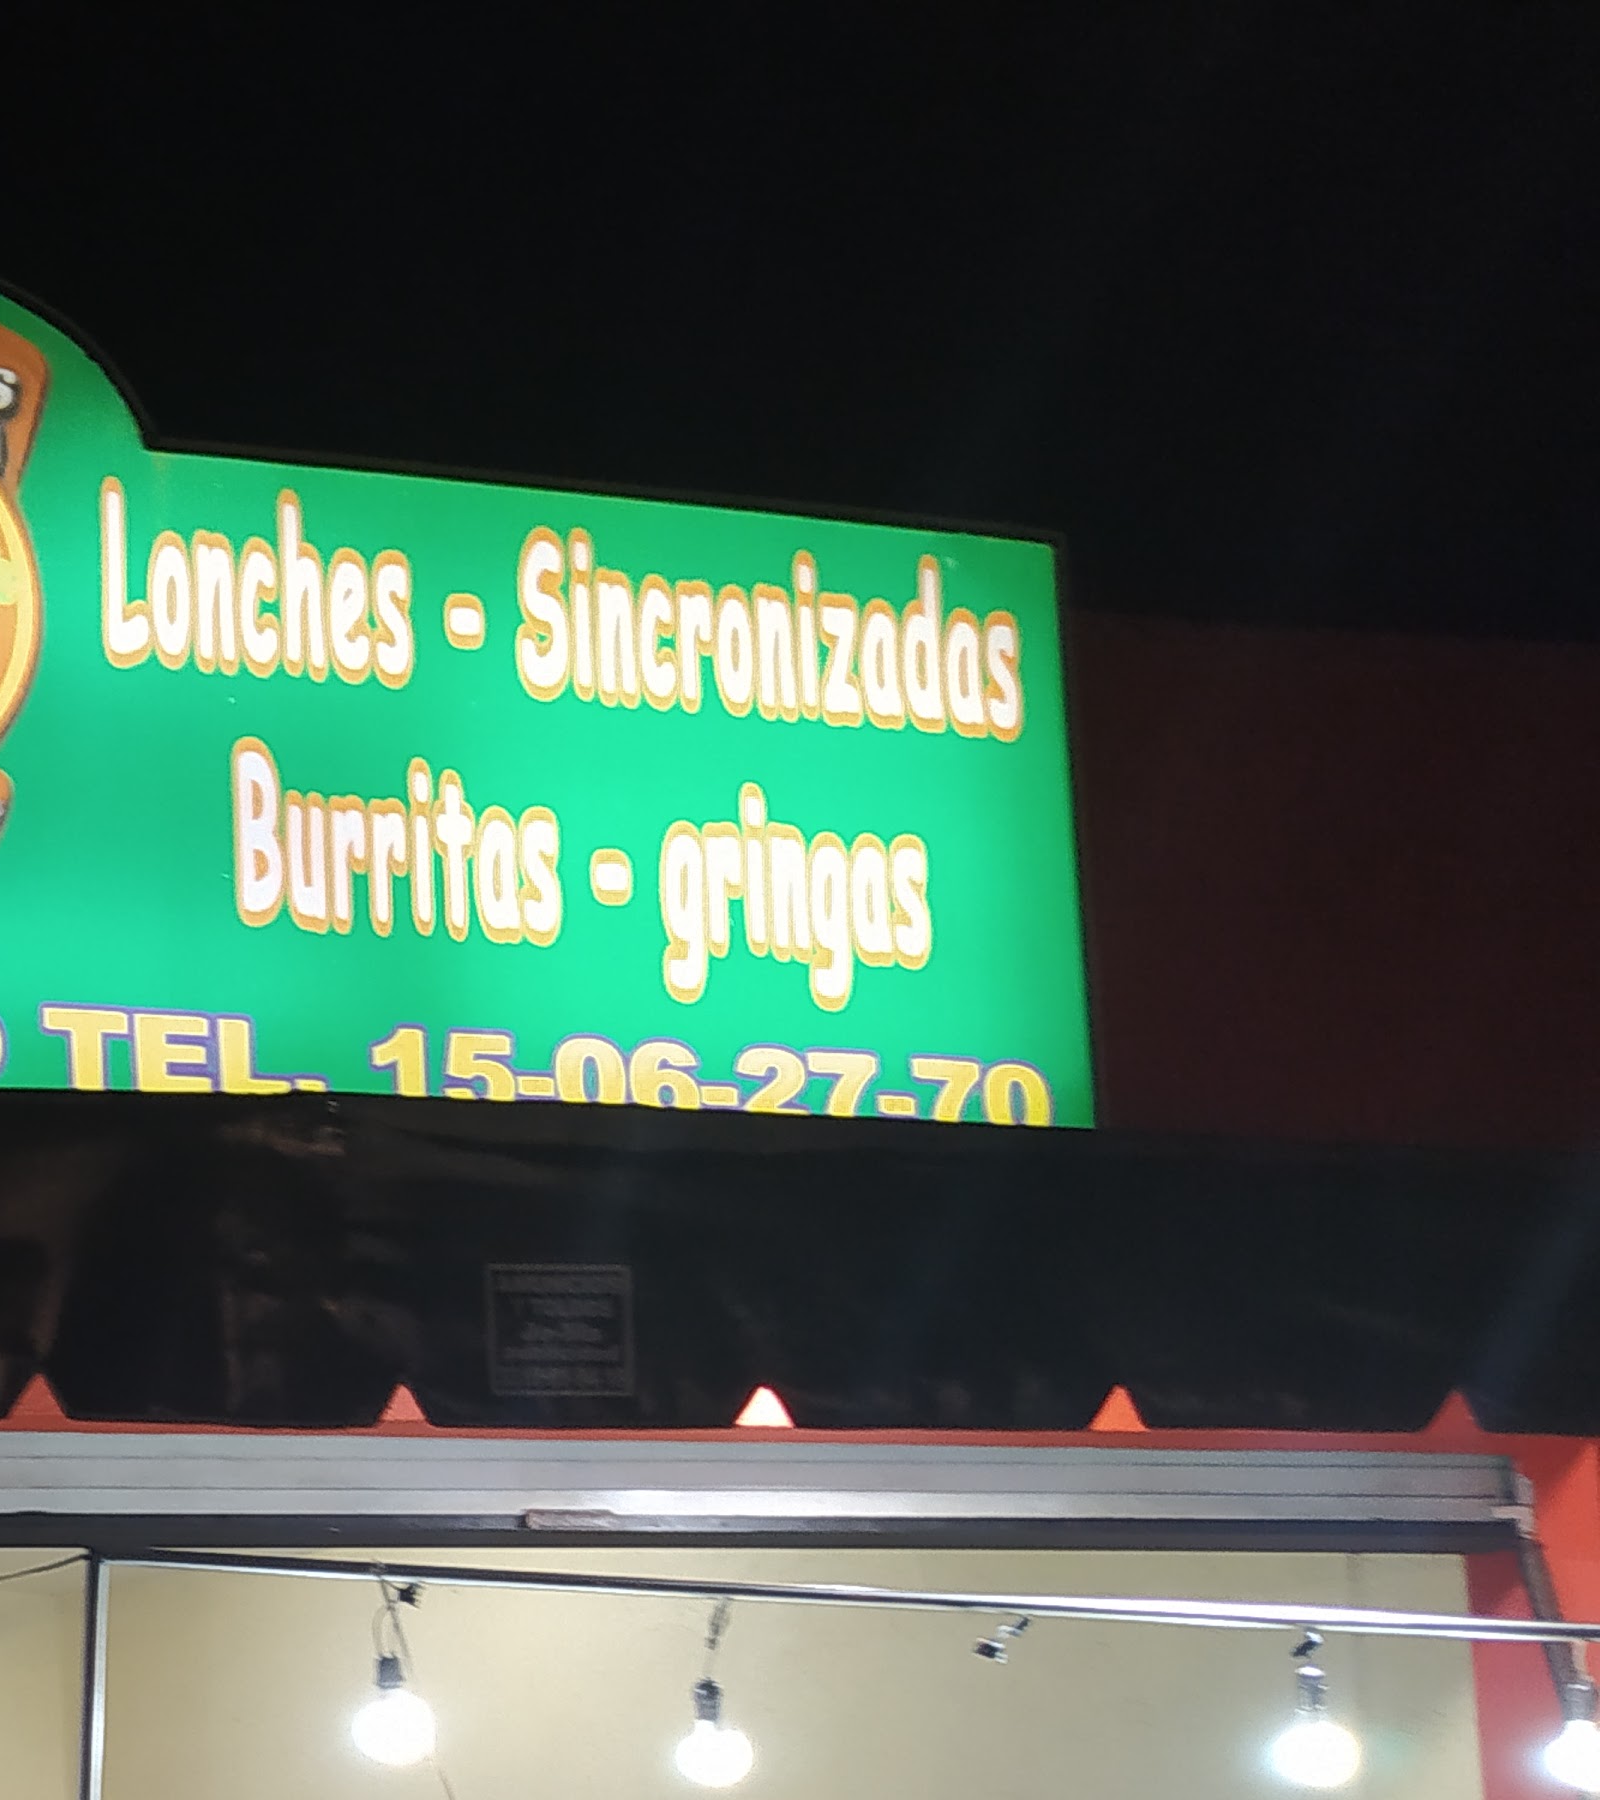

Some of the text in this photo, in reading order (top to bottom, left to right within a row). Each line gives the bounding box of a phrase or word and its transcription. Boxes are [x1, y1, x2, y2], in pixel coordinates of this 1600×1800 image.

[100, 477, 412, 688] Lonches
[515, 526, 1021, 741] Sincronizadas
[232, 736, 562, 945] Burritas
[659, 782, 932, 1011] gringas
[39, 1004, 328, 1093] TEL.
[368, 1023, 1053, 1126] 15-06-27-70
